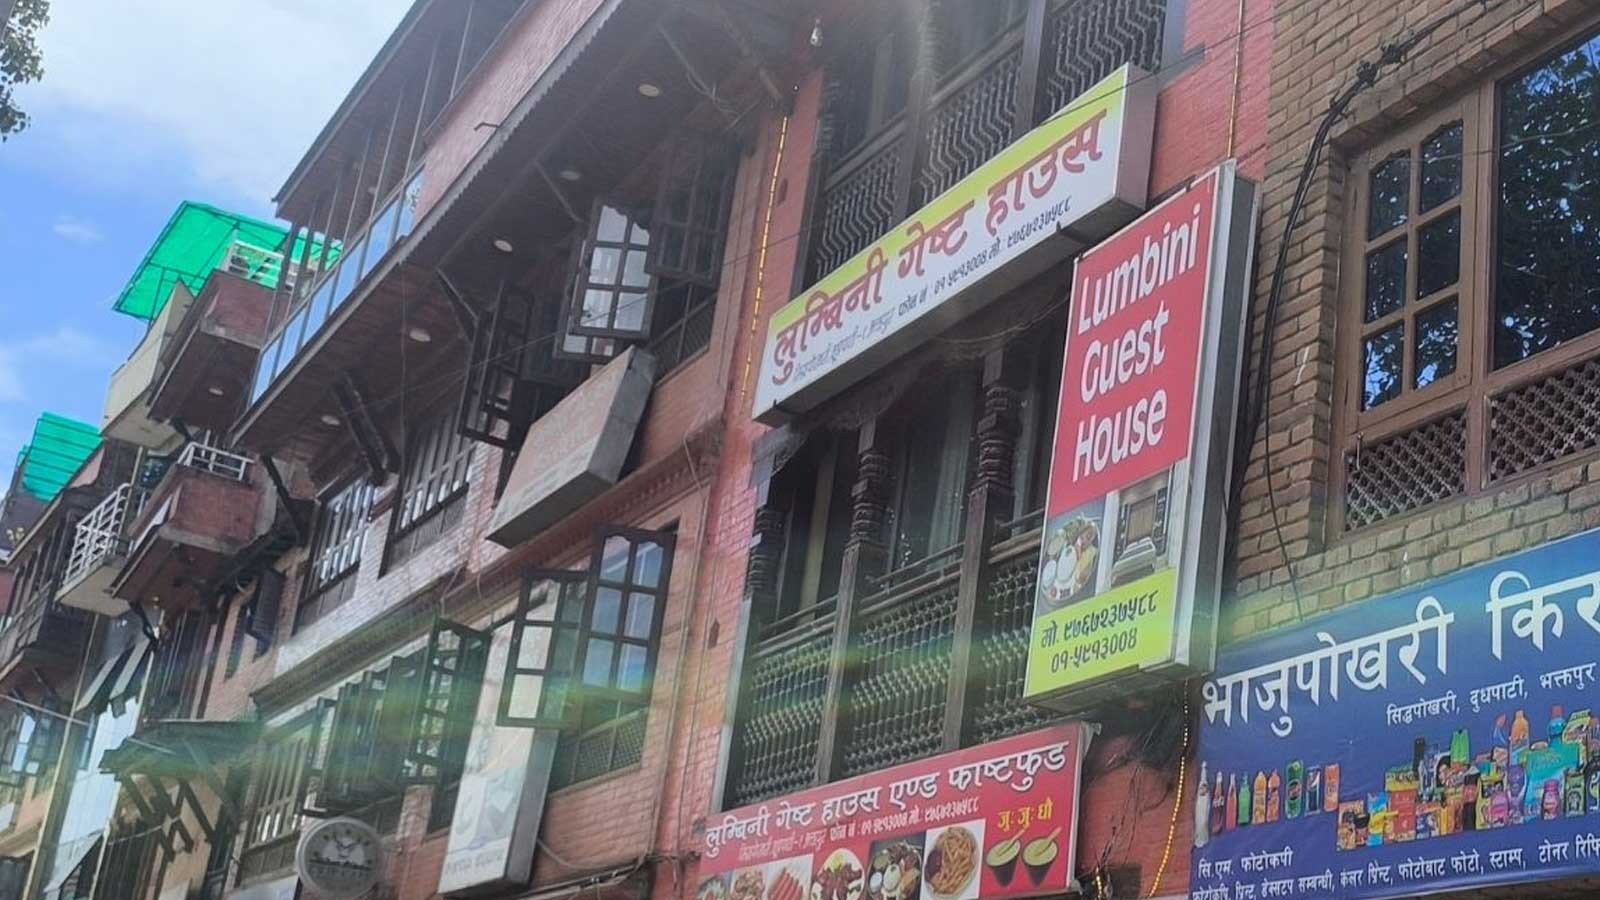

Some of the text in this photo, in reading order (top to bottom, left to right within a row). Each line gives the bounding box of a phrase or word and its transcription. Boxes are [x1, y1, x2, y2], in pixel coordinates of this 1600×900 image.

[773, 247, 888, 385] लुम्बिनी
[897, 199, 975, 279] गेष्ट
[985, 108, 1107, 237] हाउस
[1078, 203, 1201, 334] Lumbini
[1080, 300, 1169, 404] Guest
[1072, 389, 1167, 482] House
[1064, 590, 1158, 641] ९७६७२३७५८८
[1202, 596, 1455, 737] भाजुपोखरी
[1540, 662, 1597, 691] भक्तपुर
[706, 806, 771, 858] लुम्बिनी
[776, 801, 817, 830] गेष्ट
[821, 787, 883, 825] हाउस
[889, 772, 940, 811] एण्ड
[948, 741, 1070, 792] फाष्टफुड
[1241, 846, 1294, 872] फोटोकपी
[1538, 839, 1570, 863] टोनर
